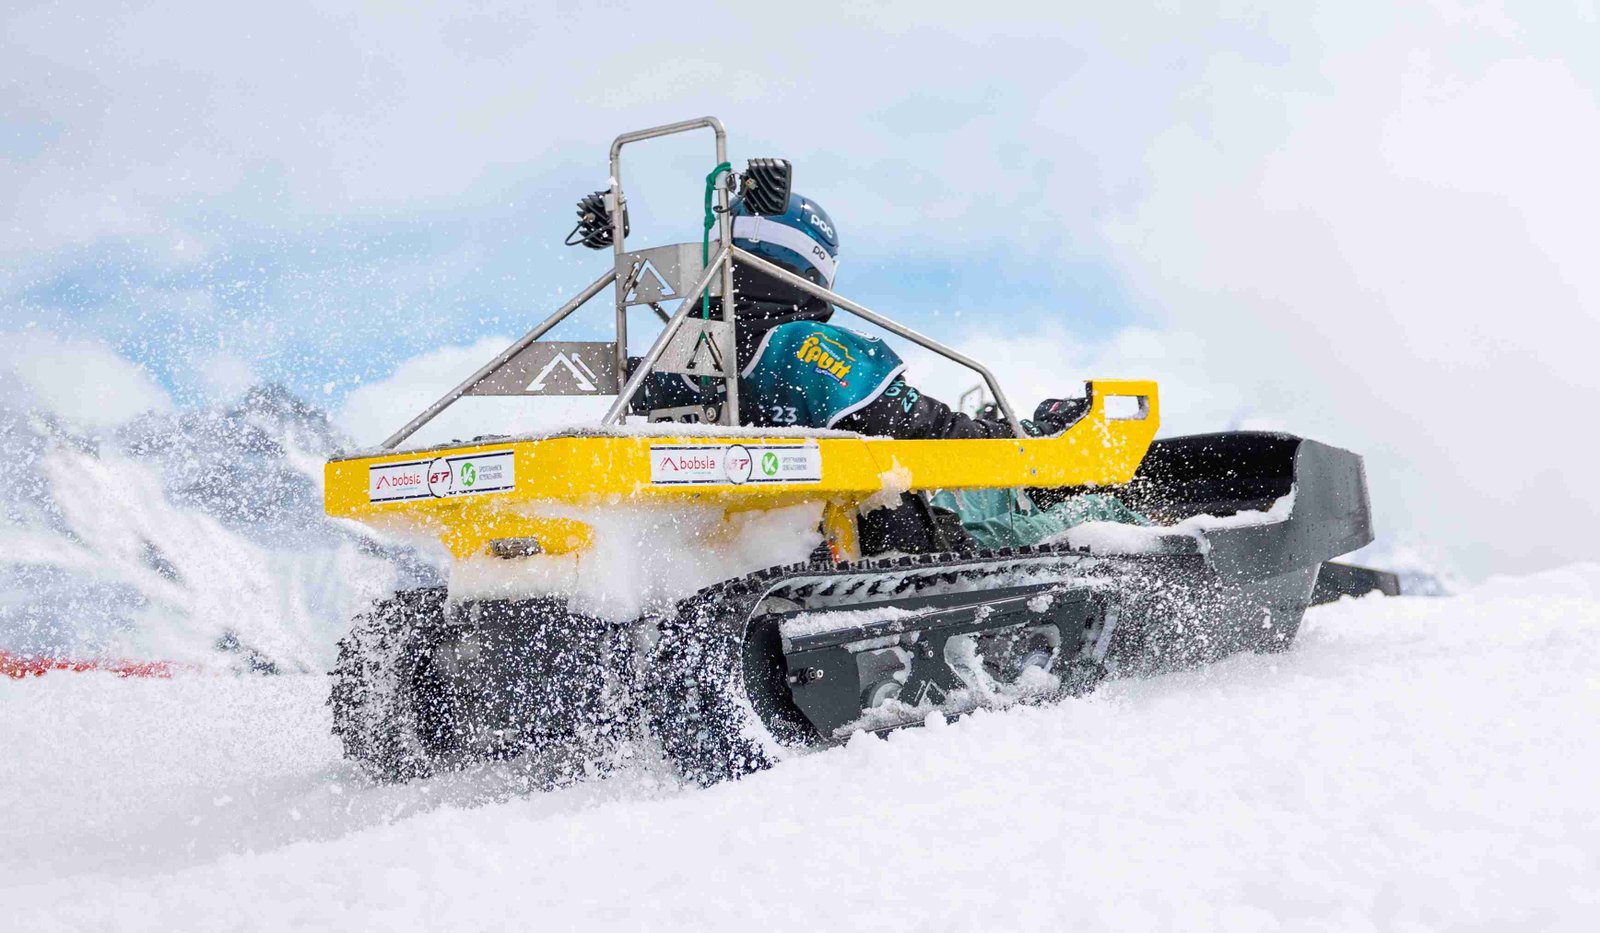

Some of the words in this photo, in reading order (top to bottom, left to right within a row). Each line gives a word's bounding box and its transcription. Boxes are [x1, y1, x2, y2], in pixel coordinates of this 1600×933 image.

[811, 214, 833, 238] poc
[771, 406, 798, 423] 23
[680, 456, 716, 470] bobsla
